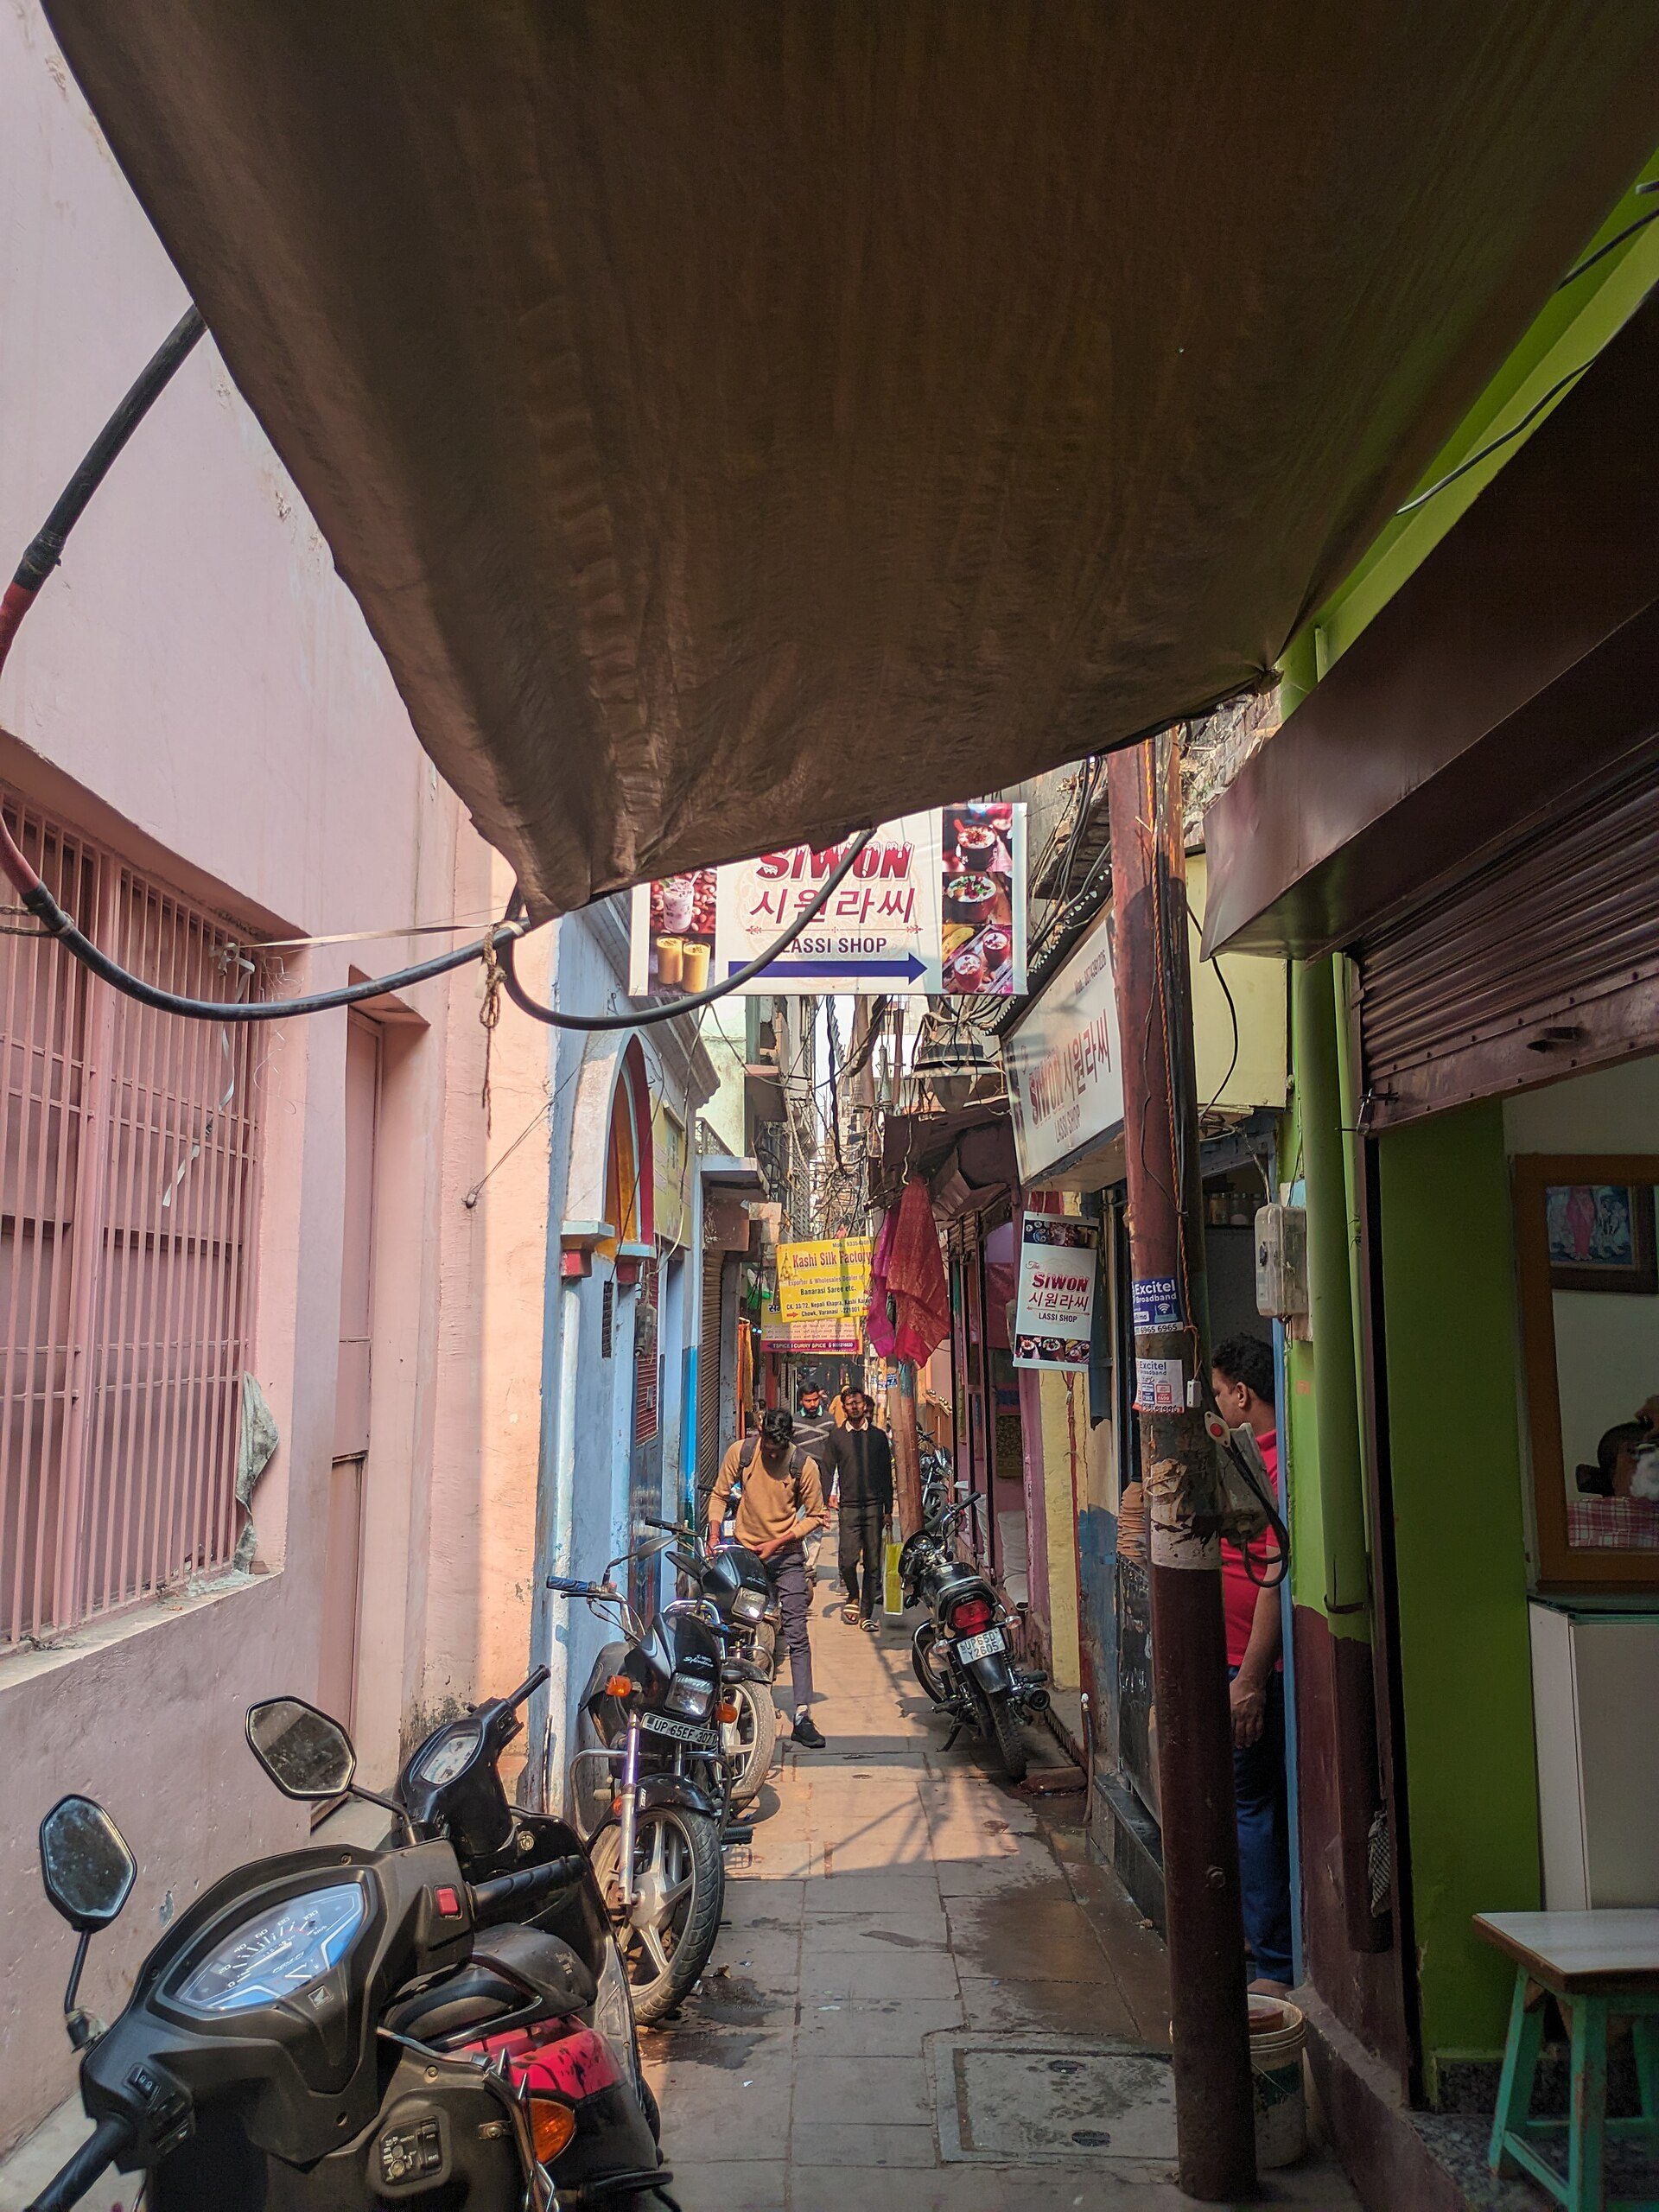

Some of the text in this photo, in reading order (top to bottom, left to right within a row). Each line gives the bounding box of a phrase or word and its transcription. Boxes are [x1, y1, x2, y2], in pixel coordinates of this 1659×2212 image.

[781, 937, 887, 954] ASSI SHOP
[1064, 1009, 1111, 1101] 시원라씨
[792, 1253, 817, 1268] Kashi
[820, 1250, 837, 1266] Silk
[1032, 1272, 1090, 1293] SIWON
[1135, 1279, 1175, 1295] Excitel
[800, 1287, 825, 1296] Banarasi
[1028, 1292, 1089, 1312] 시원라씨
[1136, 1292, 1177, 1303] Broadband
[1059, 1314, 1077, 1323] SHOP
[1157, 1323, 1177, 1332] 6965
[1140, 1361, 1166, 1370] Excitel
[653, 1719, 668, 1732] UP
[671, 1725, 695, 1739] 65EF
[303, 1910, 319, 1920] 100
[233, 1943, 247, 1953] 40
[219, 1964, 232, 1974] 20
